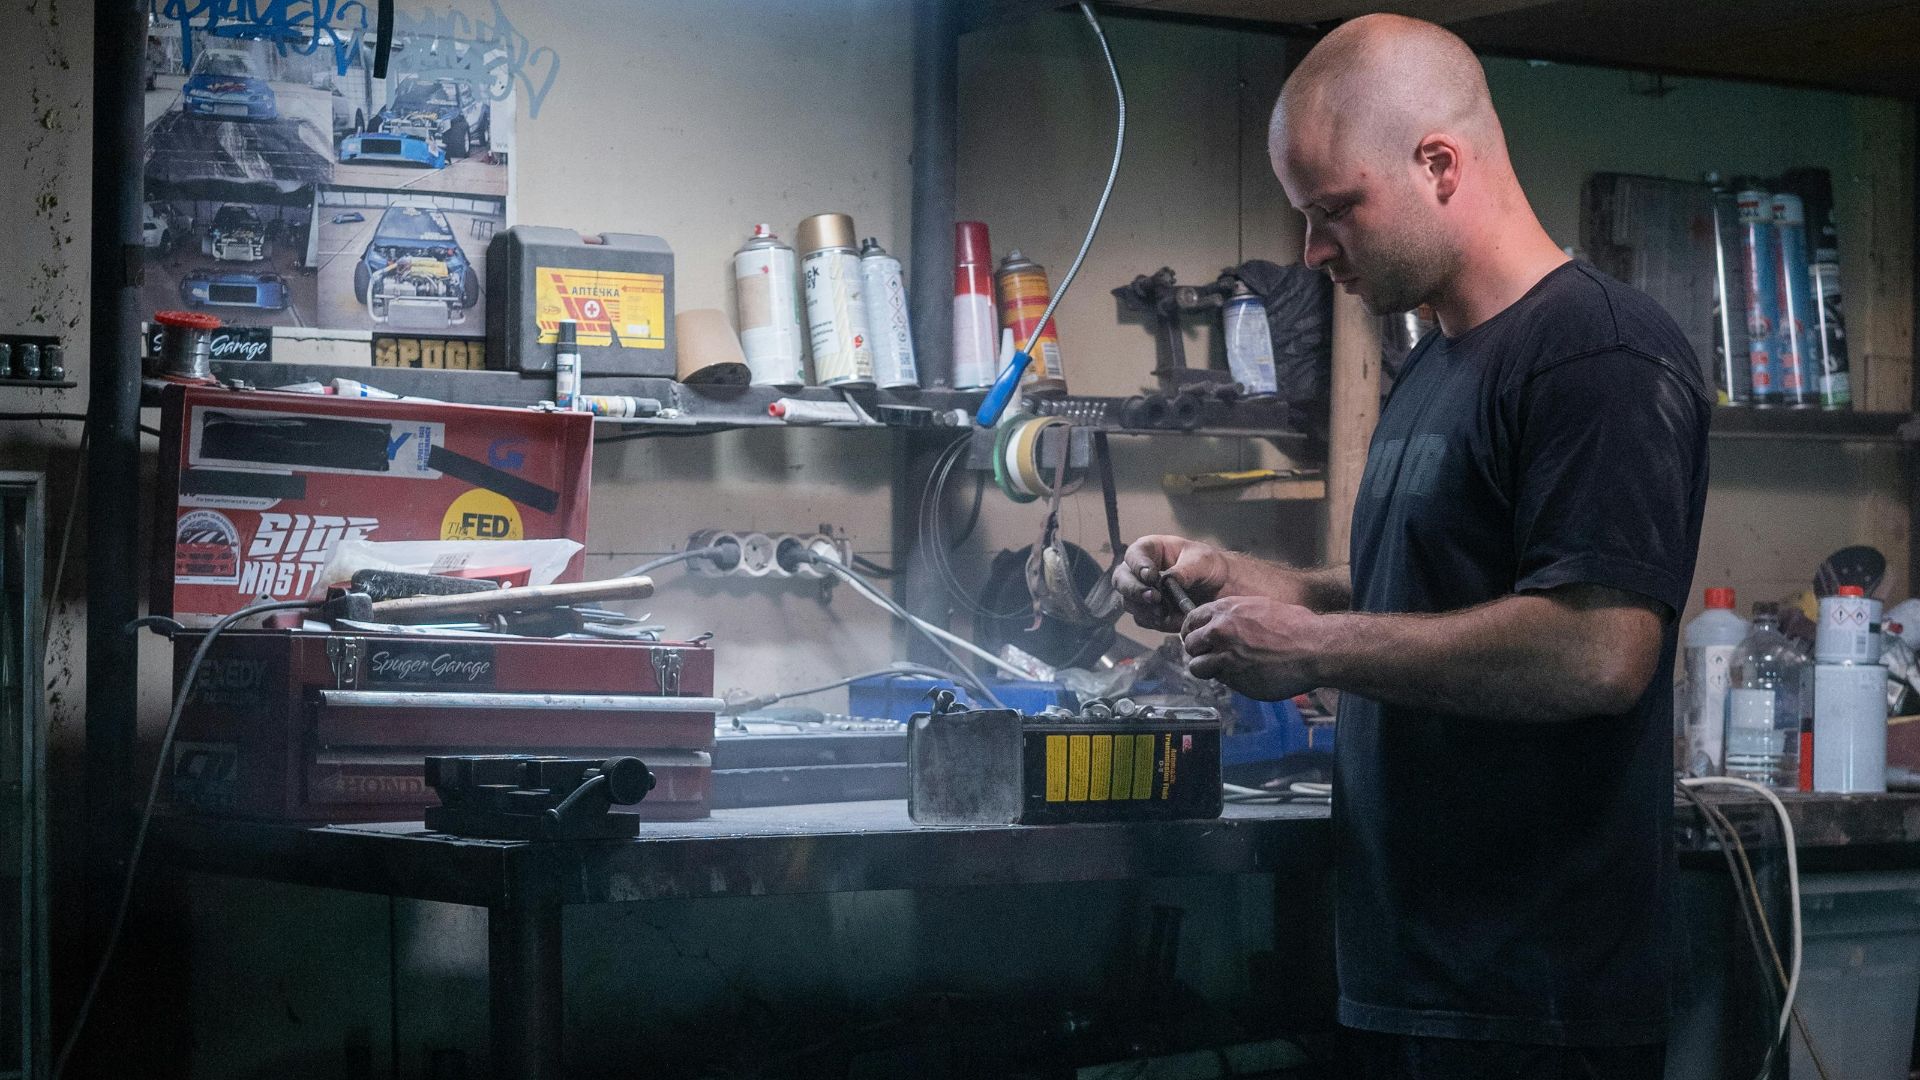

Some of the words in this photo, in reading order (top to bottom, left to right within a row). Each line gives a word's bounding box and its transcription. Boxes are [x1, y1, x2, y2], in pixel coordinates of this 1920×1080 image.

[571, 286, 620, 297] АПТЕЧКА
[210, 334, 268, 360] Garage
[462, 512, 511, 538] FED
[372, 651, 429, 679] Spuger
[430, 653, 491, 680] Garage
[1163, 733, 1171, 782] Transmission
[343, 776, 422, 793] HOND
